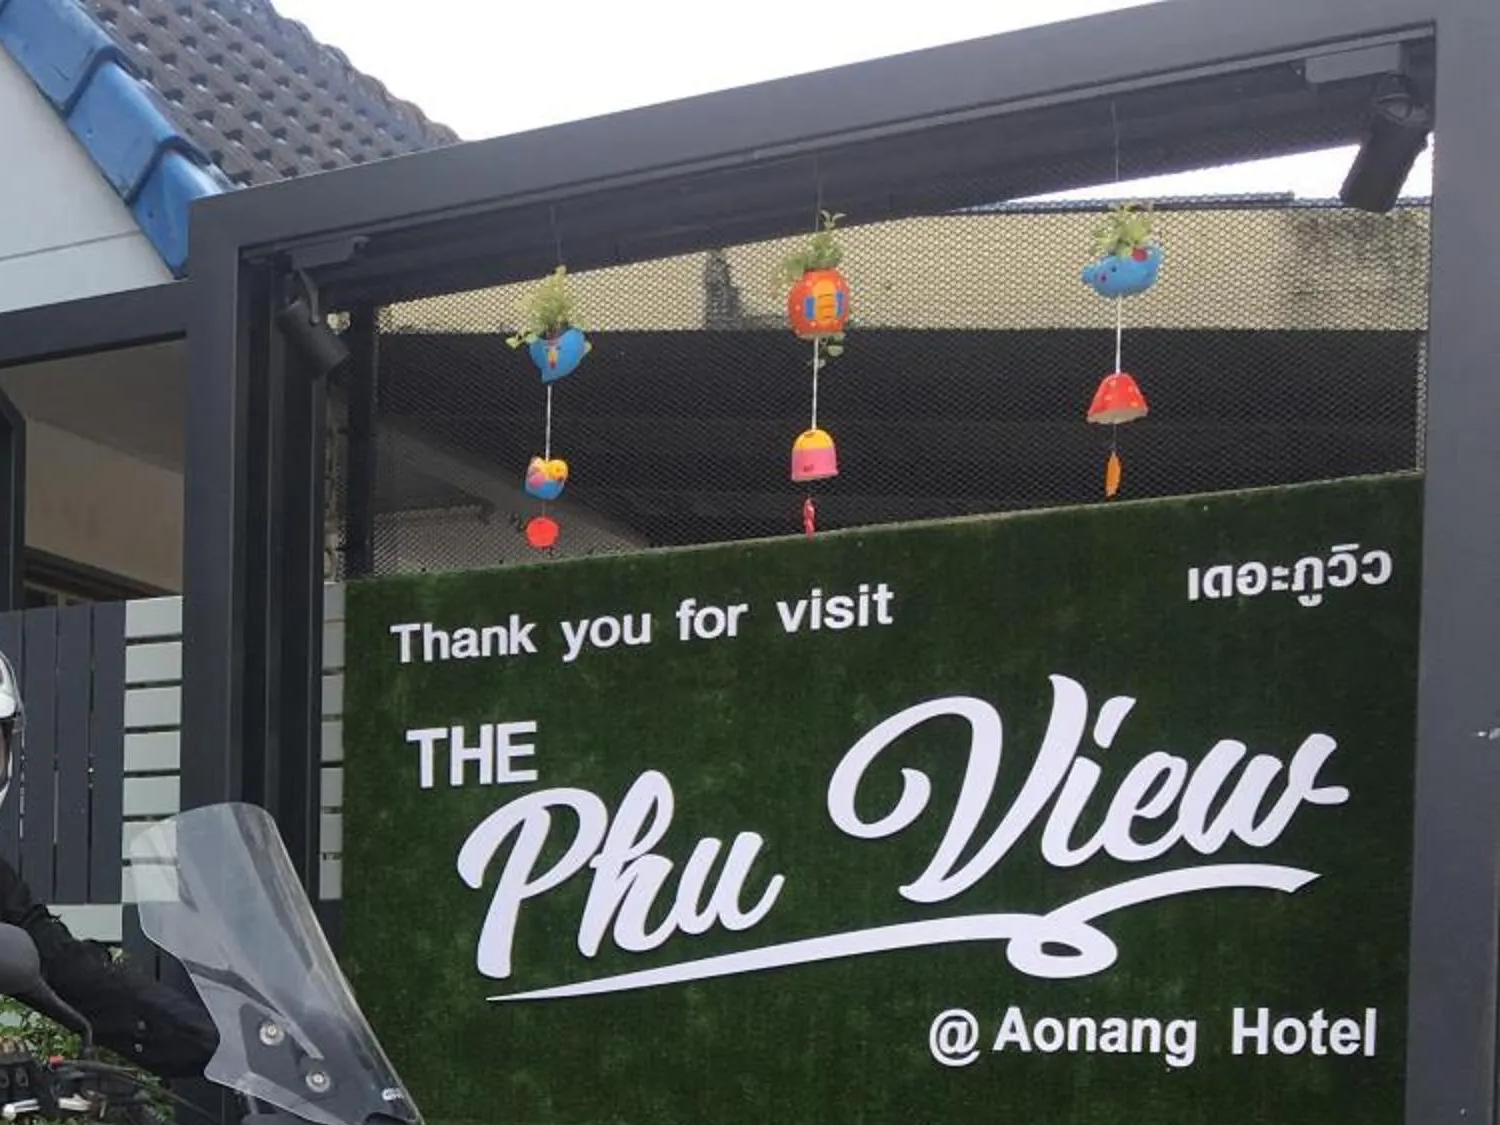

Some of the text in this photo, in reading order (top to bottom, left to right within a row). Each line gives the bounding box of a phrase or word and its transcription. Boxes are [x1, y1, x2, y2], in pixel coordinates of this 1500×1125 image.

[389, 583, 894, 663] Thank you for visit
[406, 720, 539, 789] THE
[457, 673, 1350, 979] Phu View
[992, 1005, 1197, 1068] Aonang
[1231, 1007, 1378, 1057] Hotel
